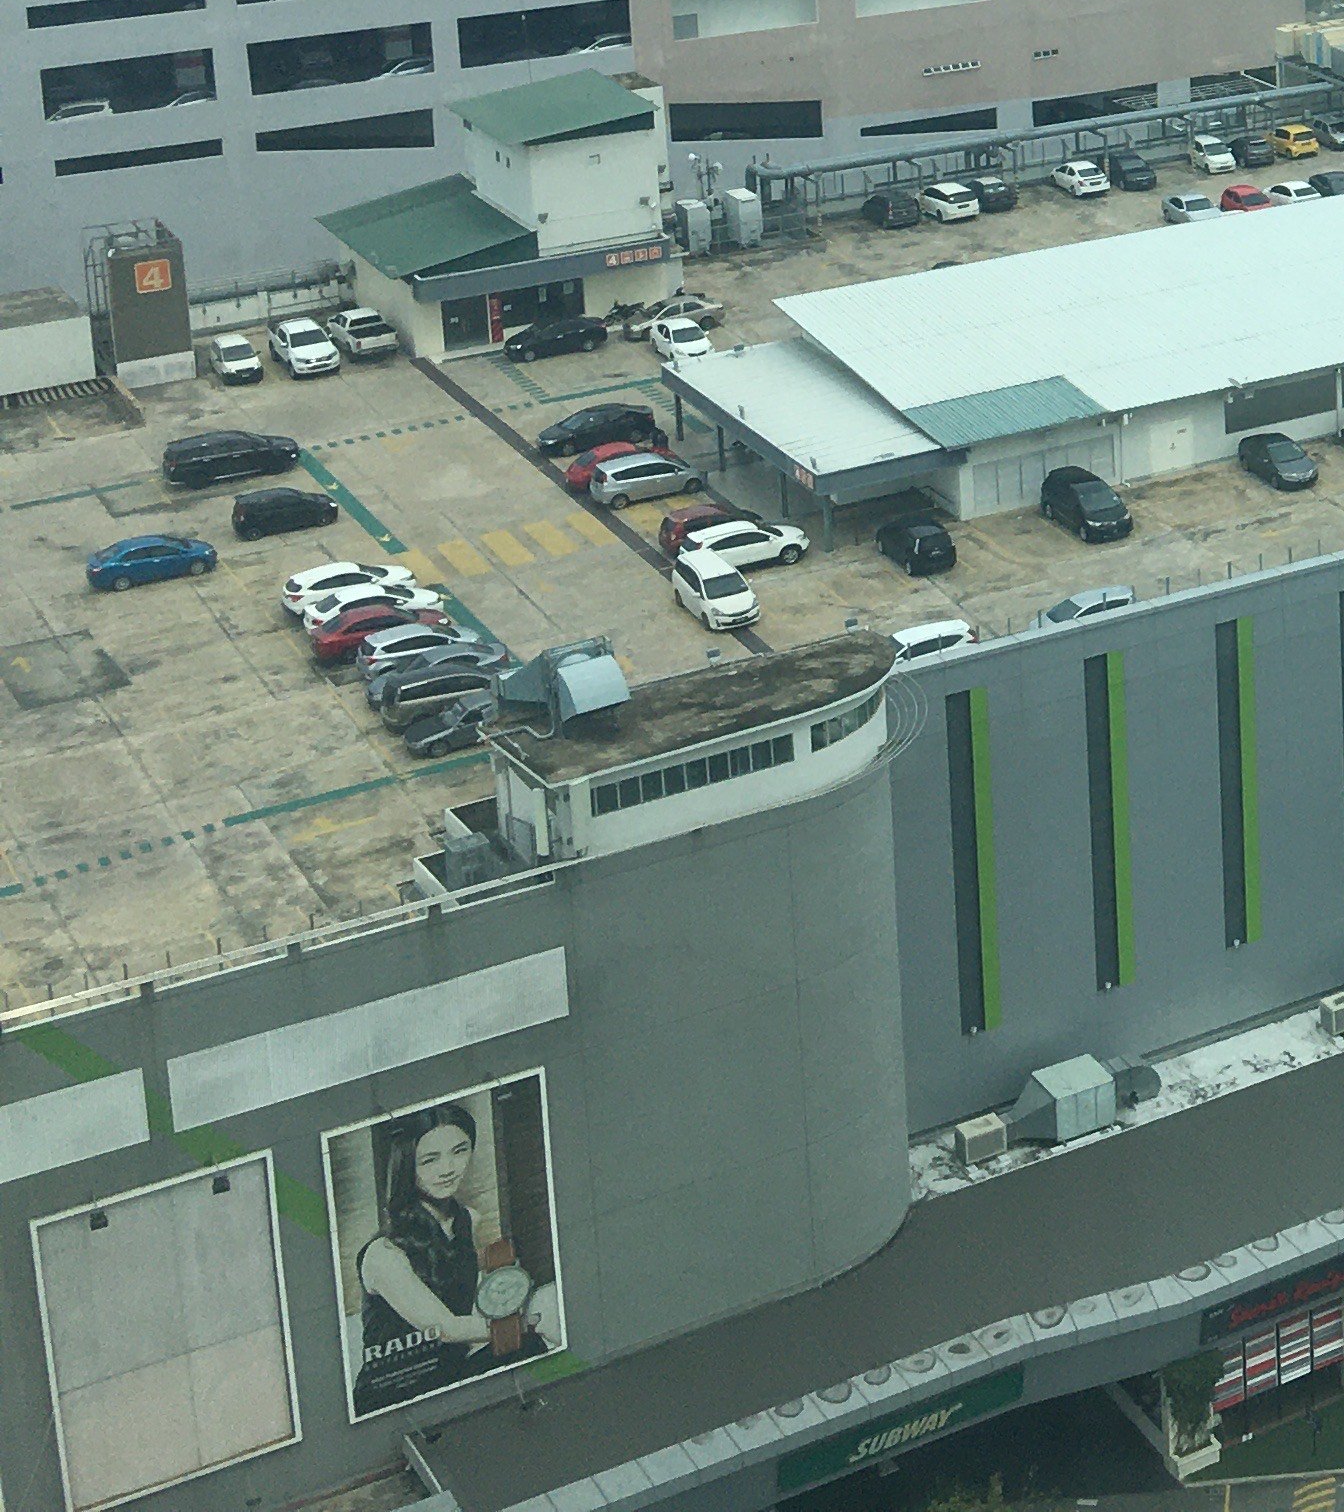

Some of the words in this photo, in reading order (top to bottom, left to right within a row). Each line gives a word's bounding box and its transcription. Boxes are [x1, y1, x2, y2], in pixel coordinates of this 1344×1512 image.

[142, 266, 164, 289] 4
[364, 1324, 441, 1363] RADO
[849, 1402, 964, 1463] SUBWAY
